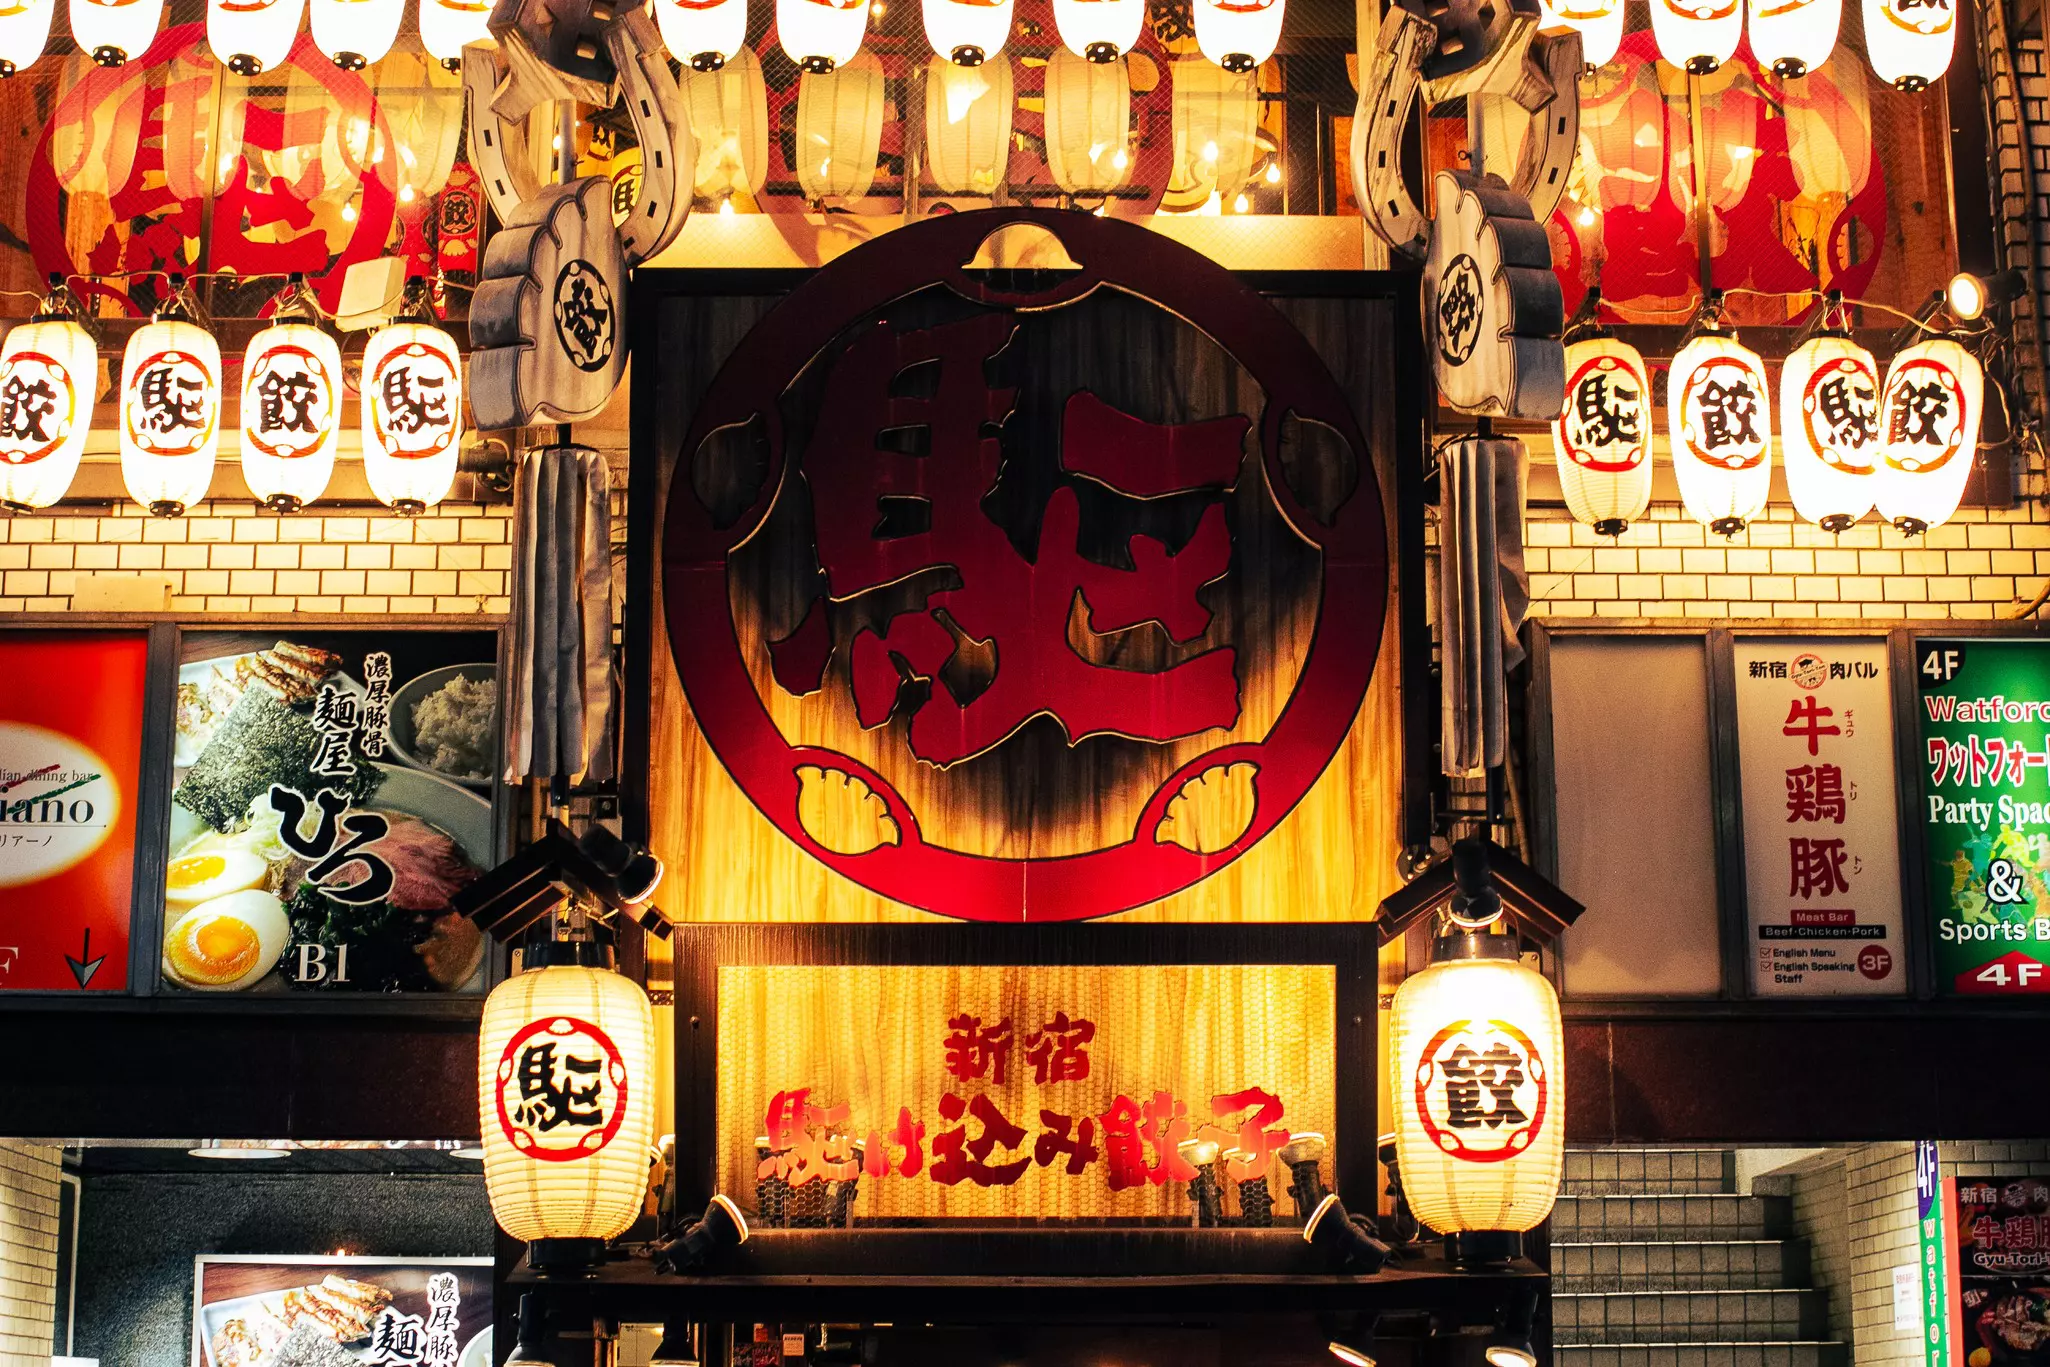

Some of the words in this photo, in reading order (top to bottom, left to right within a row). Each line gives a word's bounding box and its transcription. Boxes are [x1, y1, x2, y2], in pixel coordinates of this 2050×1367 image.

[1749, 661, 1787, 679] 新宿
[1830, 661, 1879, 679] 肉バル
[1923, 650, 1959, 681] 4F
[363, 652, 392, 757] 濃厚豚骨
[72, 770, 94, 782] bar
[1928, 734, 2050, 787] ワットフォー
[1928, 795, 1993, 831] Party
[268, 783, 396, 905] ひろ
[1986, 859, 2024, 904] &
[1796, 912, 1825, 922] Meat
[1829, 912, 1849, 922] Bar
[1940, 918, 2027, 944] Sports
[294, 943, 350, 983] B1
[1773, 948, 1808, 959] English
[1810, 948, 1836, 958] Menu
[1774, 962, 1808, 973] English
[1811, 962, 1855, 973] Speaking
[1862, 955, 1889, 971] 3F
[1774, 973, 1803, 984] Staff
[1976, 963, 2043, 987] 4F
[943, 1010, 1096, 1085] 新宿
[757, 1086, 1291, 1192] 駆け込み餃子
[1916, 1142, 1936, 1198] 4F
[1961, 1187, 1997, 1203] 新宿
[427, 1273, 460, 1367] 濃厚豚
[374, 1312, 424, 1367] 麺
